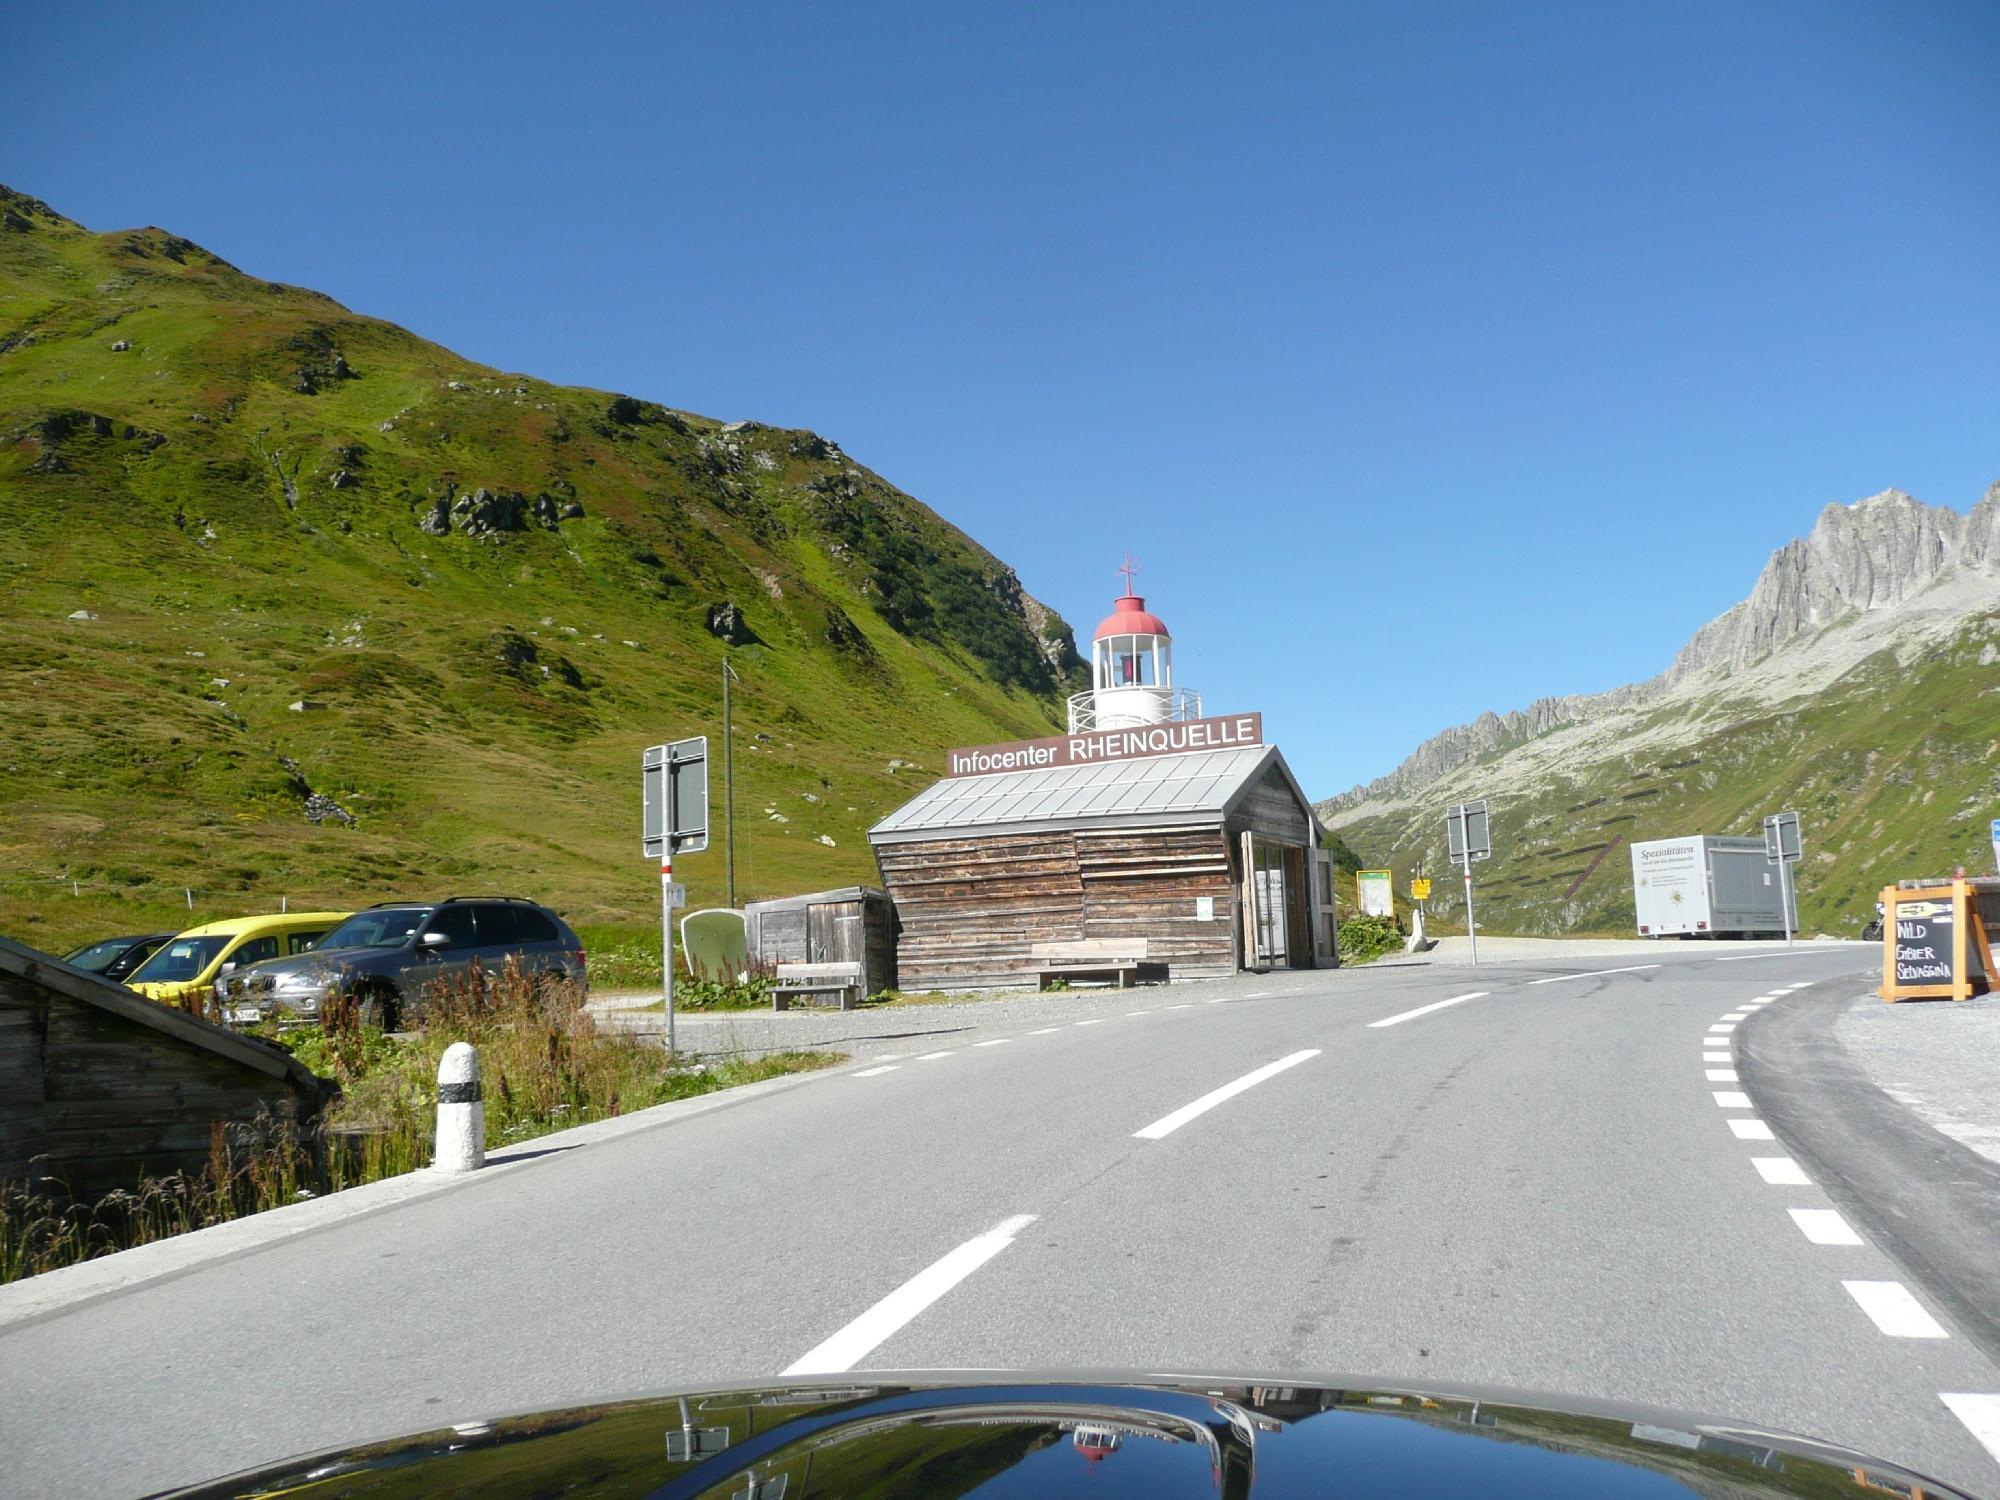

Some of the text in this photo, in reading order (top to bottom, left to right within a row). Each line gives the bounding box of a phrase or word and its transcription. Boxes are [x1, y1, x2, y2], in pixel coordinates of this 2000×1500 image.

[953, 718, 1255, 774] Infocenter RHEINQUELLE
[1641, 846, 1694, 860] Spezialitäten
